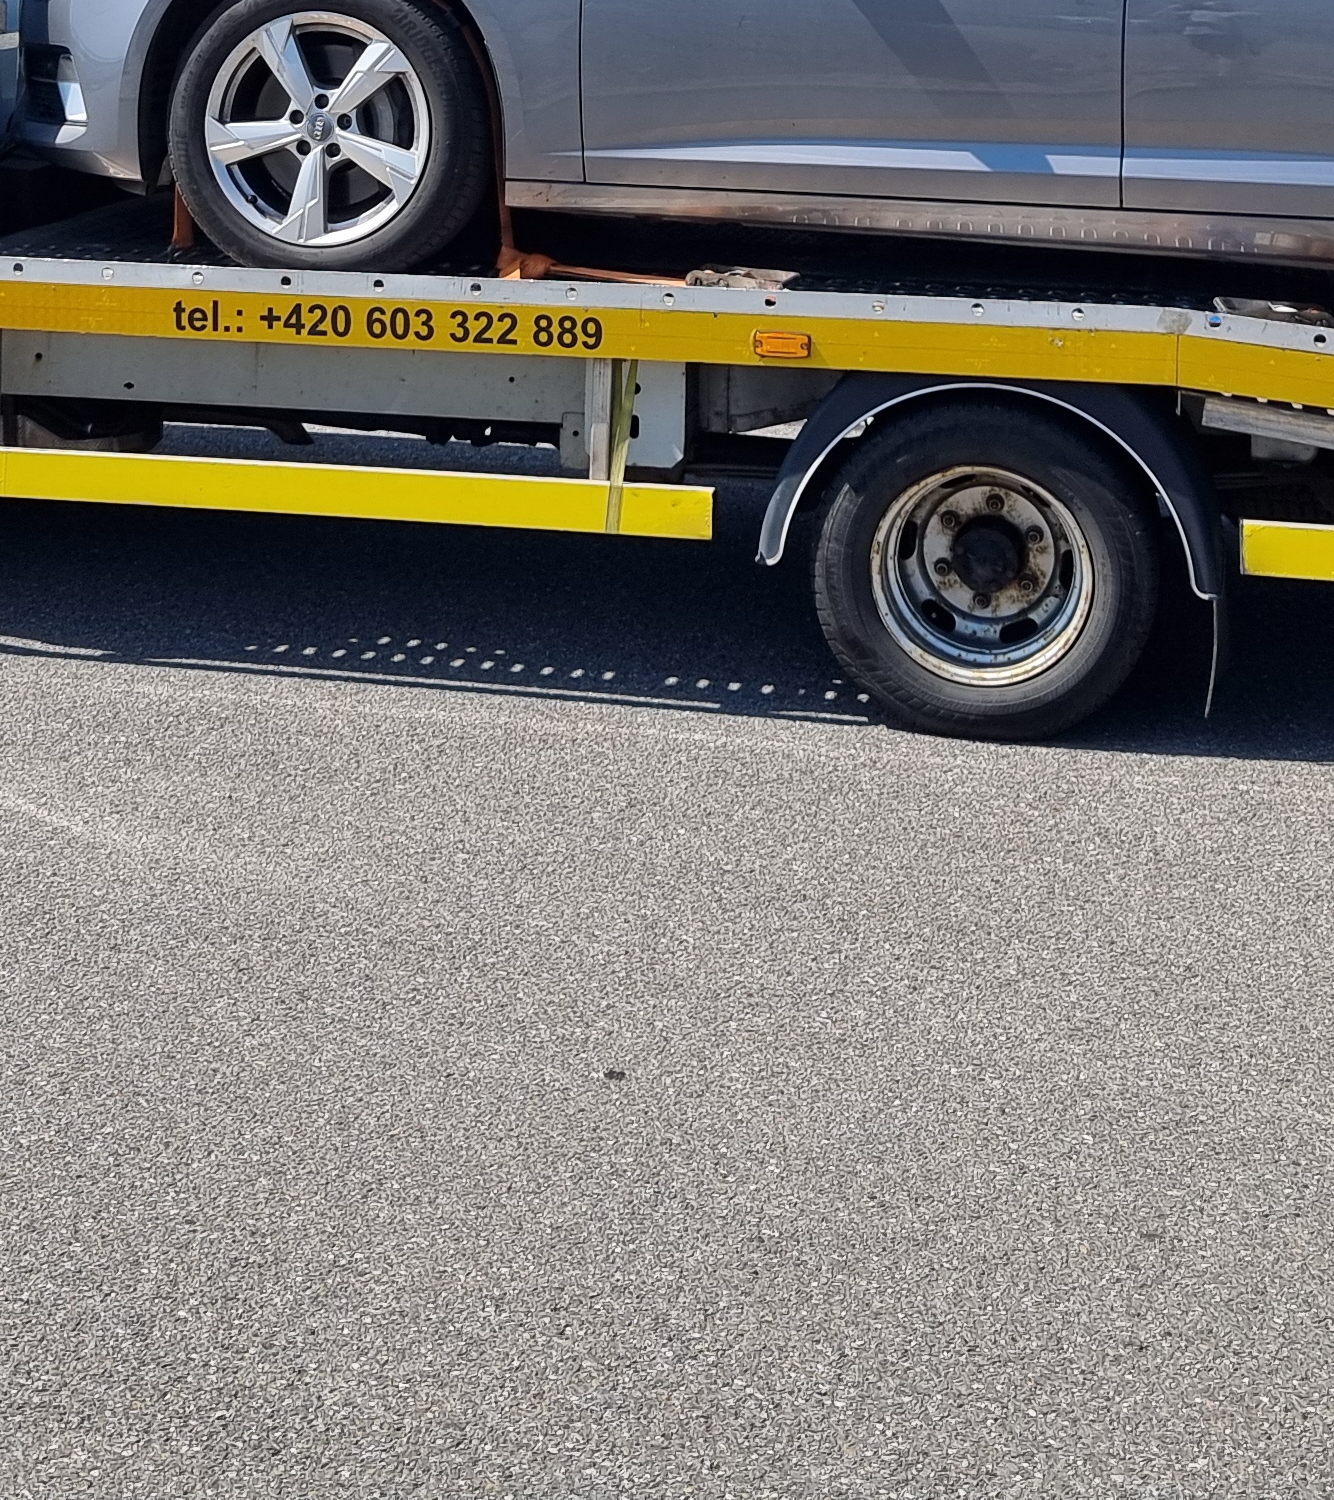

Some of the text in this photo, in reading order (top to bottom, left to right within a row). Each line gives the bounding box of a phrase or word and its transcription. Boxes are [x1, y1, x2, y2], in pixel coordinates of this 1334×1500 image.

[173, 300, 603, 350] tel.: +420 603 322 889
